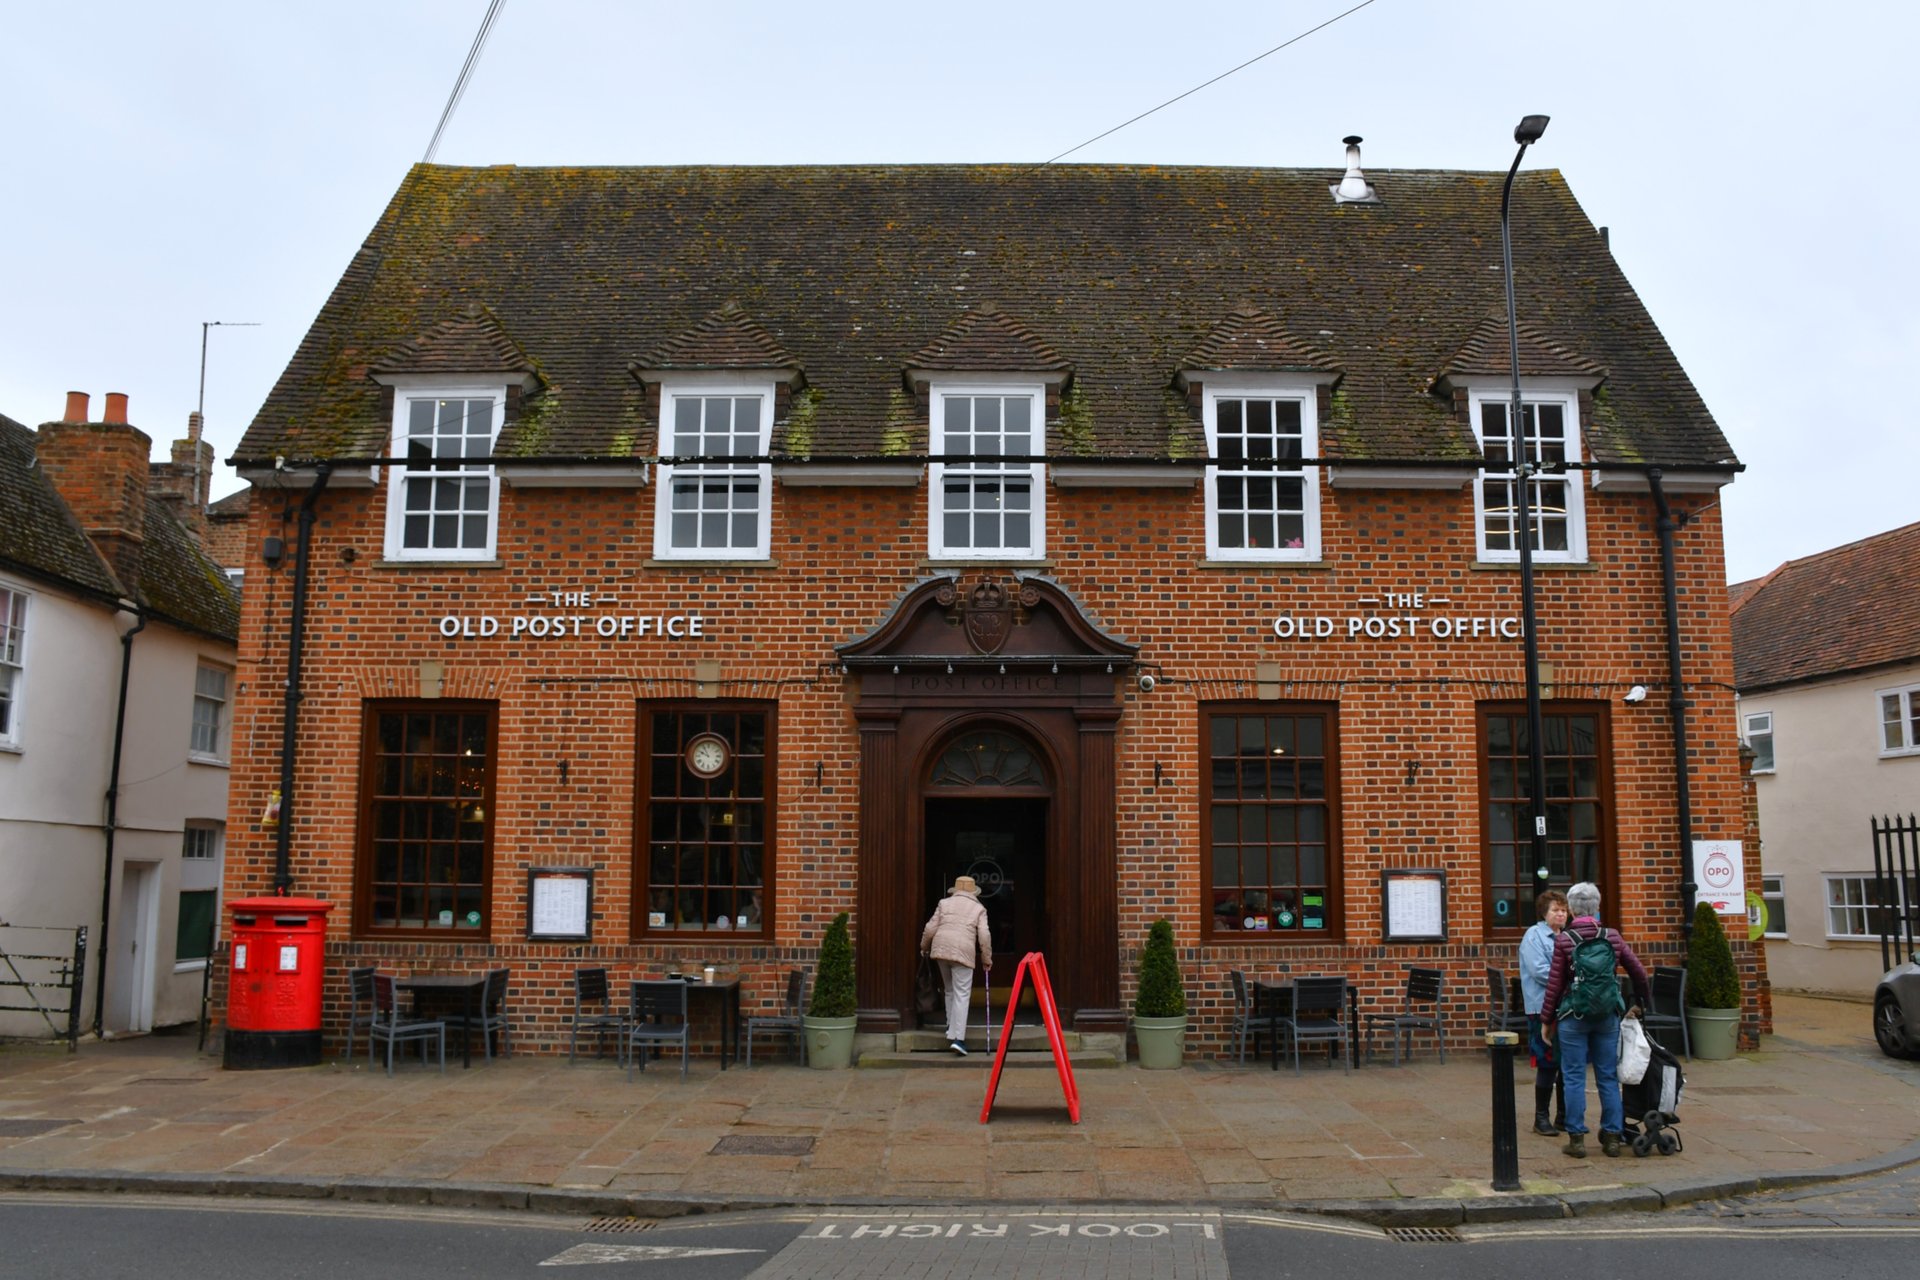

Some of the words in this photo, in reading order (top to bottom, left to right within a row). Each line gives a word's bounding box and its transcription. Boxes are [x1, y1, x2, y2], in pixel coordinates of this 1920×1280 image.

[551, 592, 591, 607] THE
[1384, 593, 1424, 608] THE
[439, 615, 499, 637] OLD
[512, 615, 586, 637] POST
[596, 615, 704, 637] OFFICE
[1274, 616, 1334, 638] OLD
[1348, 616, 1420, 638] POST
[910, 676, 968, 691] POST
[981, 676, 1064, 691] OFFICE
[1707, 867, 1730, 876] OPO
[798, 1222, 1009, 1239] RIGHT
[1029, 1222, 1217, 1239] LOOK
